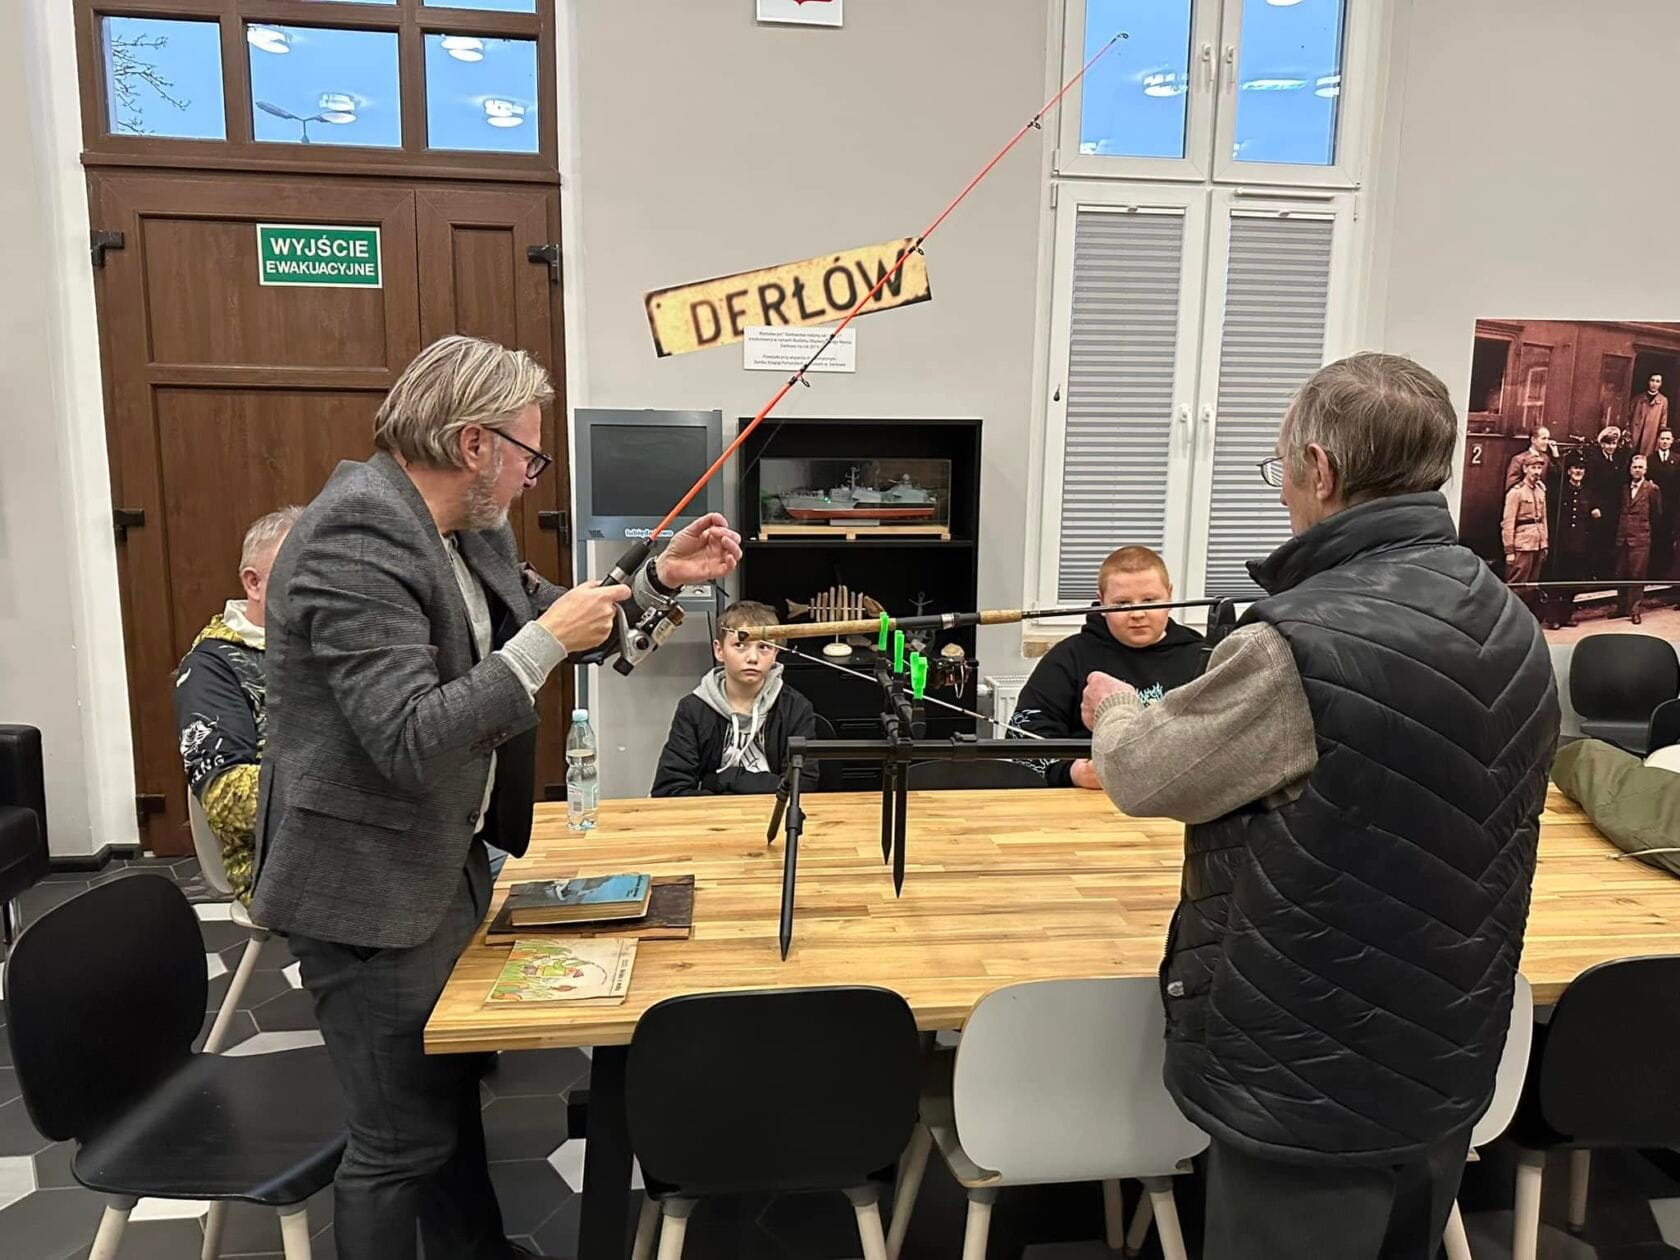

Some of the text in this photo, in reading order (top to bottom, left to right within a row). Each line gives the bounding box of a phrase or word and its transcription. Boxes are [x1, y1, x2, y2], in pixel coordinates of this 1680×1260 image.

[270, 235, 369, 257] WYJŚCIE
[266, 260, 375, 276] EWAKUACYJNE
[690, 248, 906, 346] DERŁÓW
[1472, 446, 1482, 464] 2
